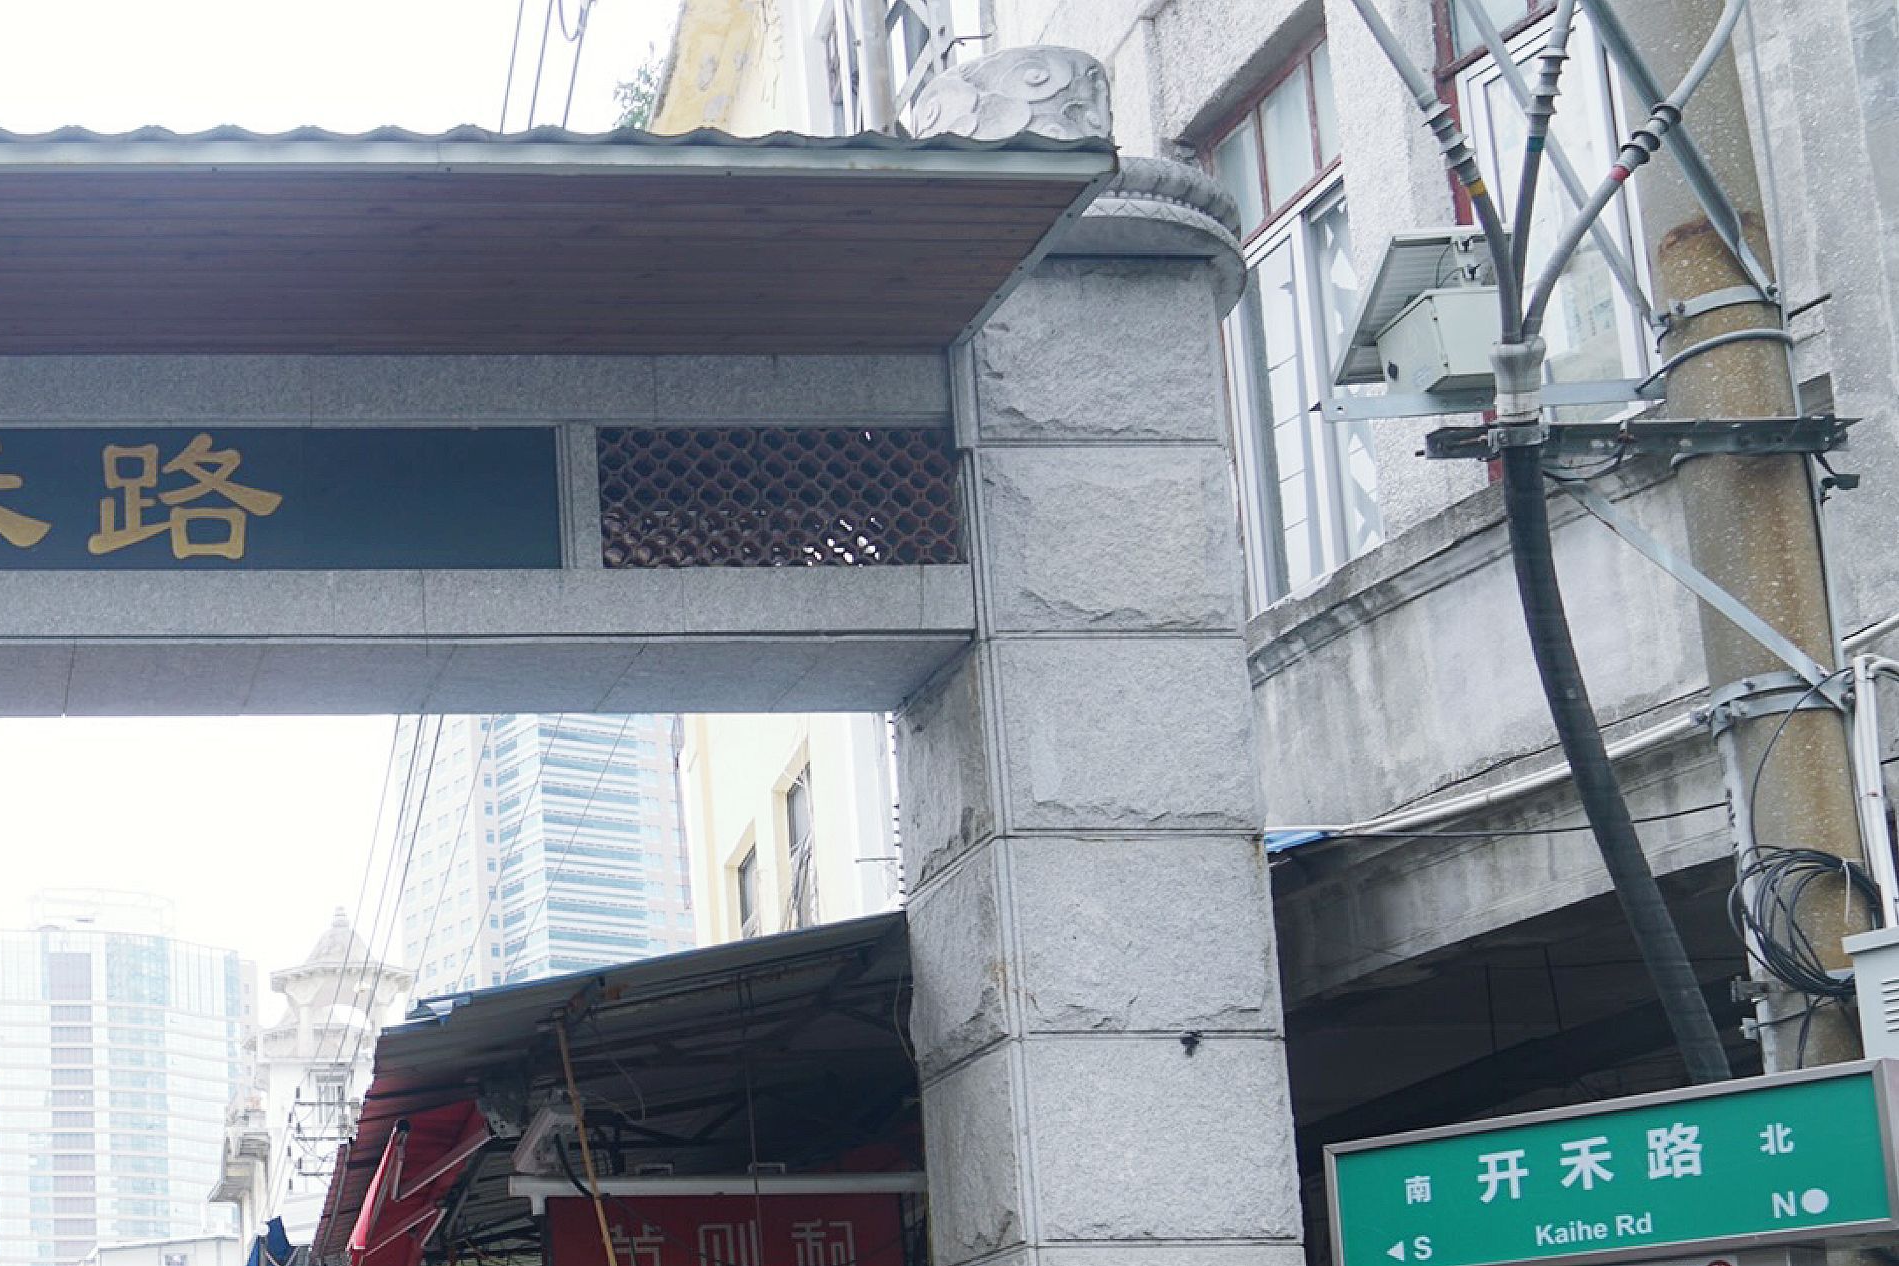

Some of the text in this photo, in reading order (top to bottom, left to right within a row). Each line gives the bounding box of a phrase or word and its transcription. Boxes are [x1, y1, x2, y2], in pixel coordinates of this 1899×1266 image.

[1404, 1122, 1794, 1205] 南 开禾路 北
[1413, 1191, 1797, 1260] S Kaihe Rd N
